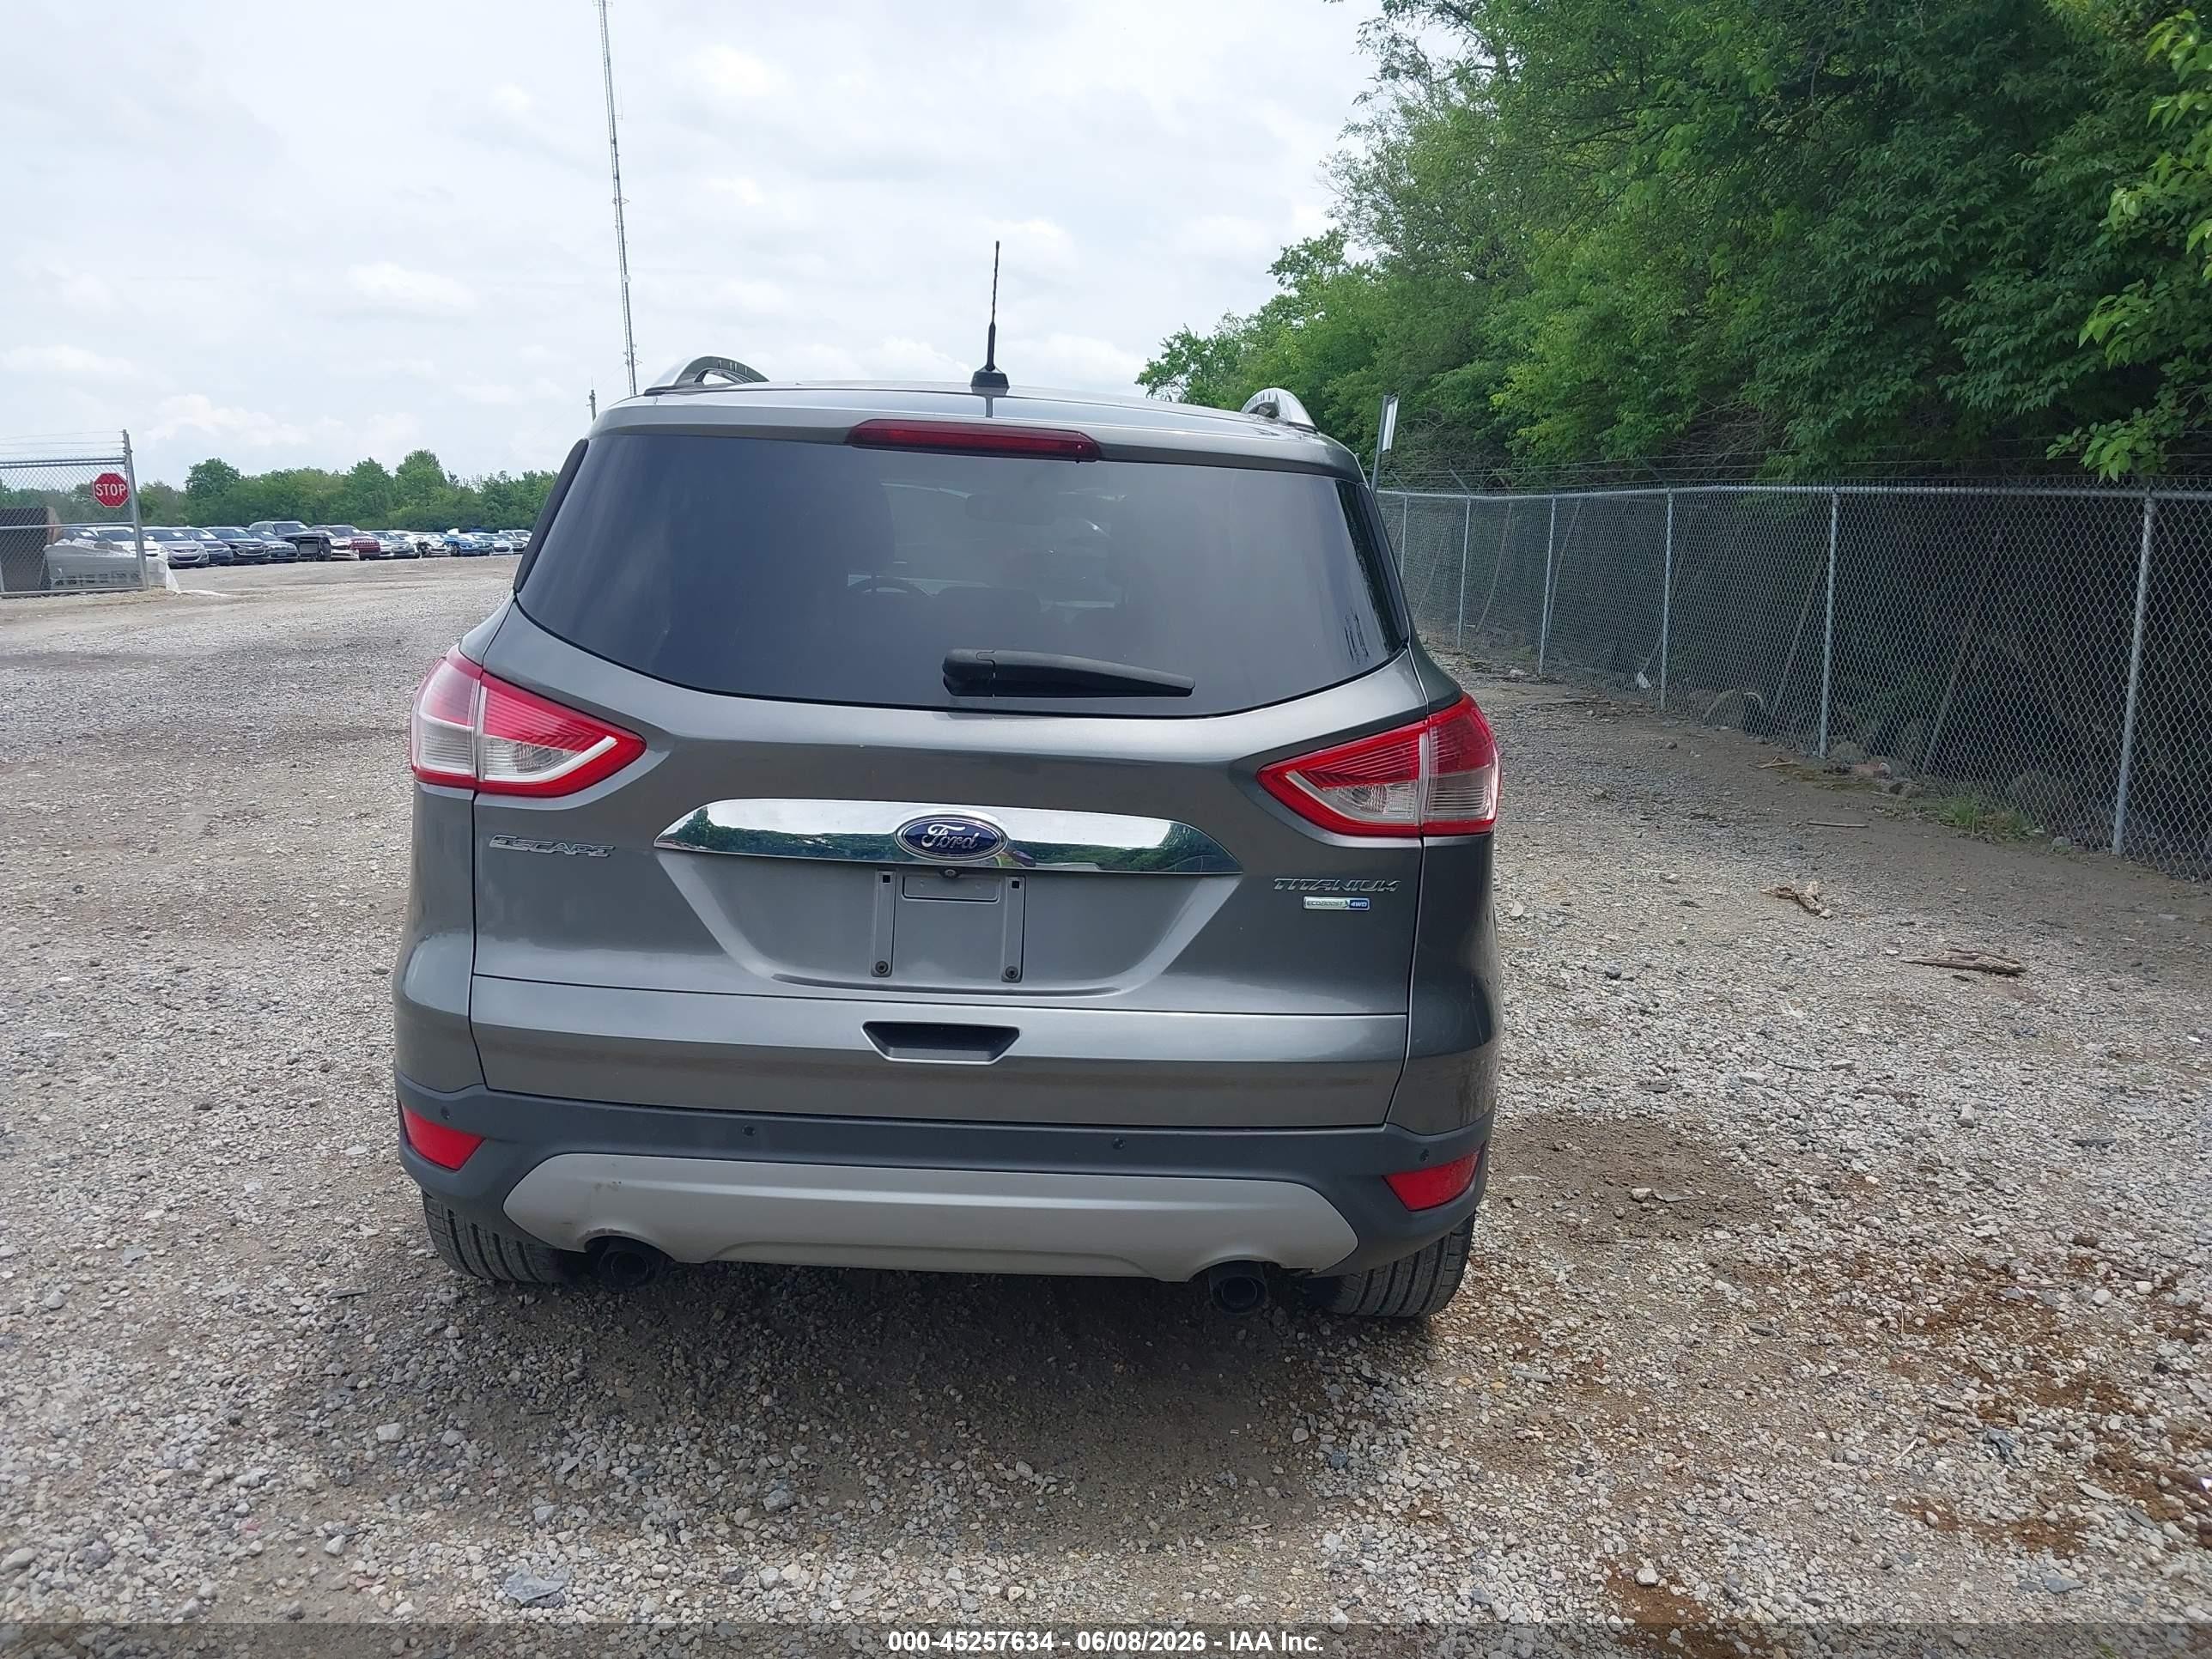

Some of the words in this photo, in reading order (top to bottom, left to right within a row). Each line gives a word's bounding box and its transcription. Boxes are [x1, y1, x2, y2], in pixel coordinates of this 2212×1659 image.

[95, 483, 126, 496] STOP
[921, 824, 980, 849] Ford
[489, 835, 615, 857] ESCAPE
[1273, 878, 1401, 892] TITANIUM
